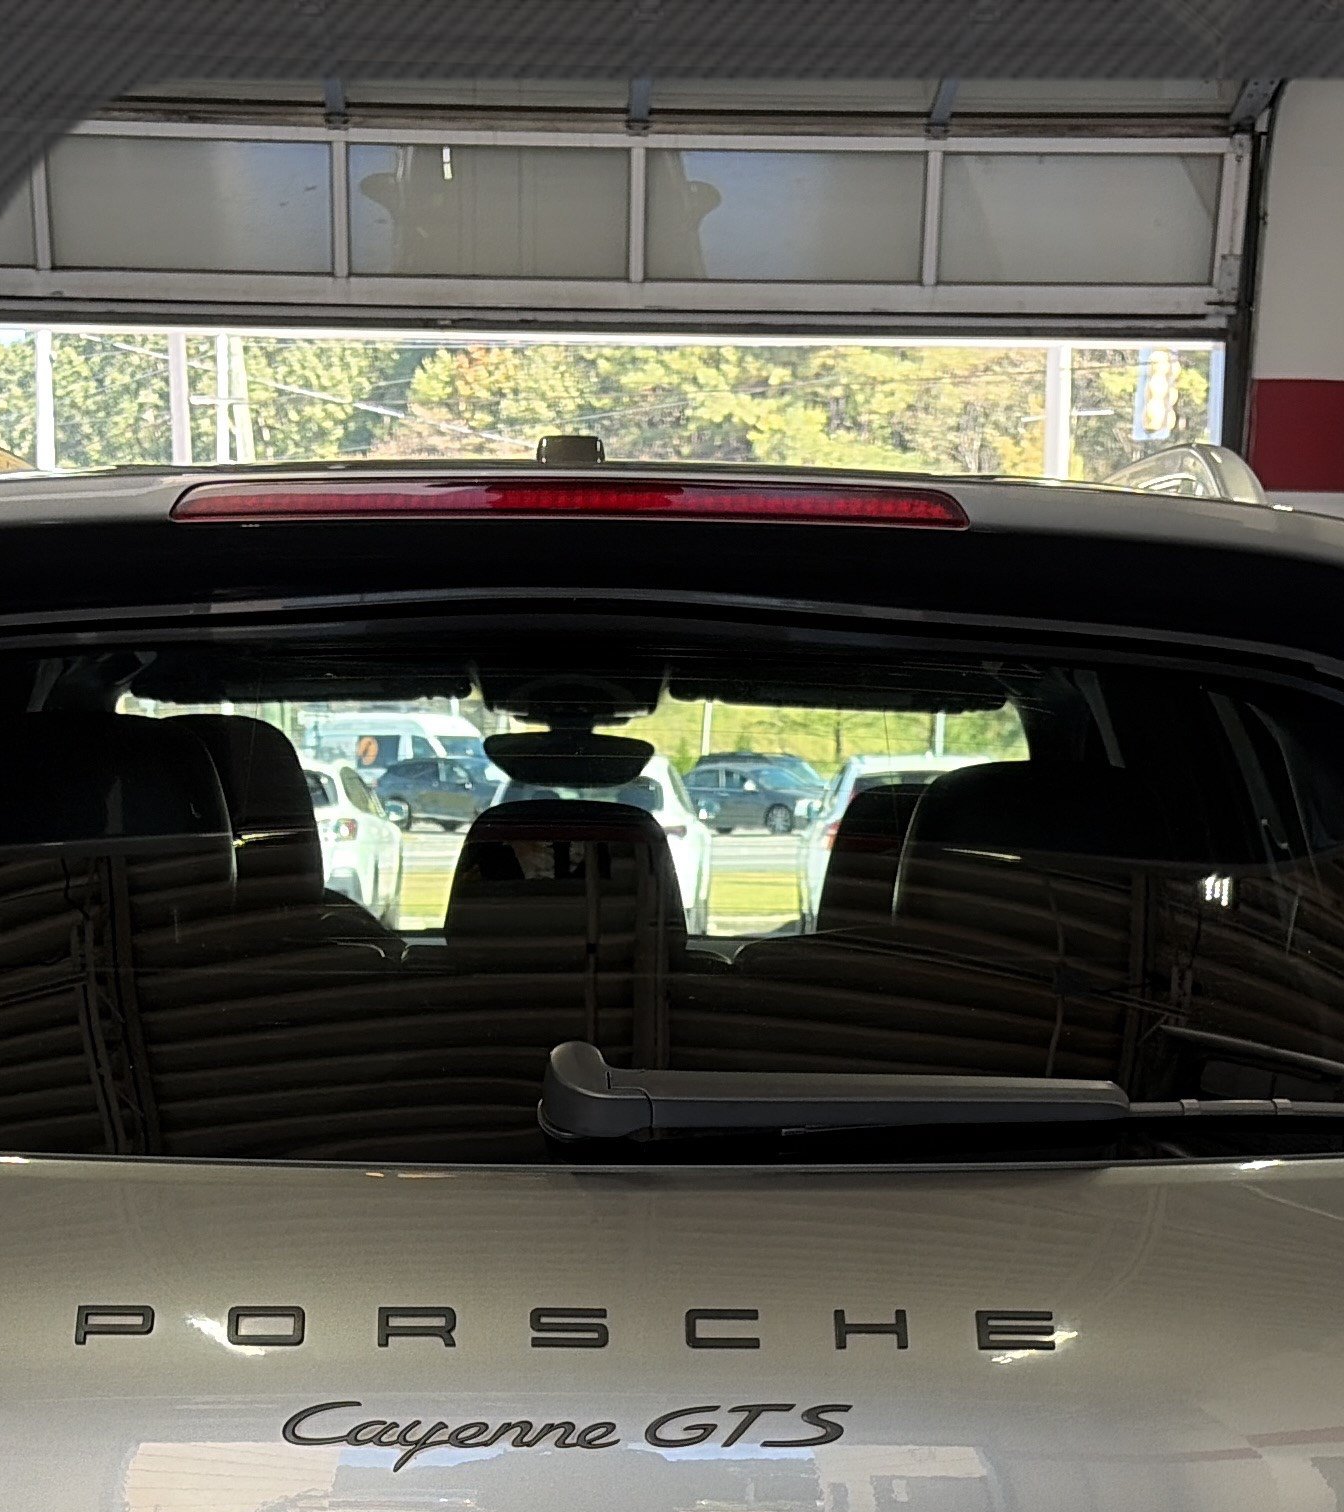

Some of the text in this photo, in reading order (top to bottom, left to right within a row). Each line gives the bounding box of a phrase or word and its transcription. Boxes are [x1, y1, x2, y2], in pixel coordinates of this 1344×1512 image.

[74, 1304, 1057, 1351] PORSCHE
[281, 1400, 854, 1473] Cayenne GTS
